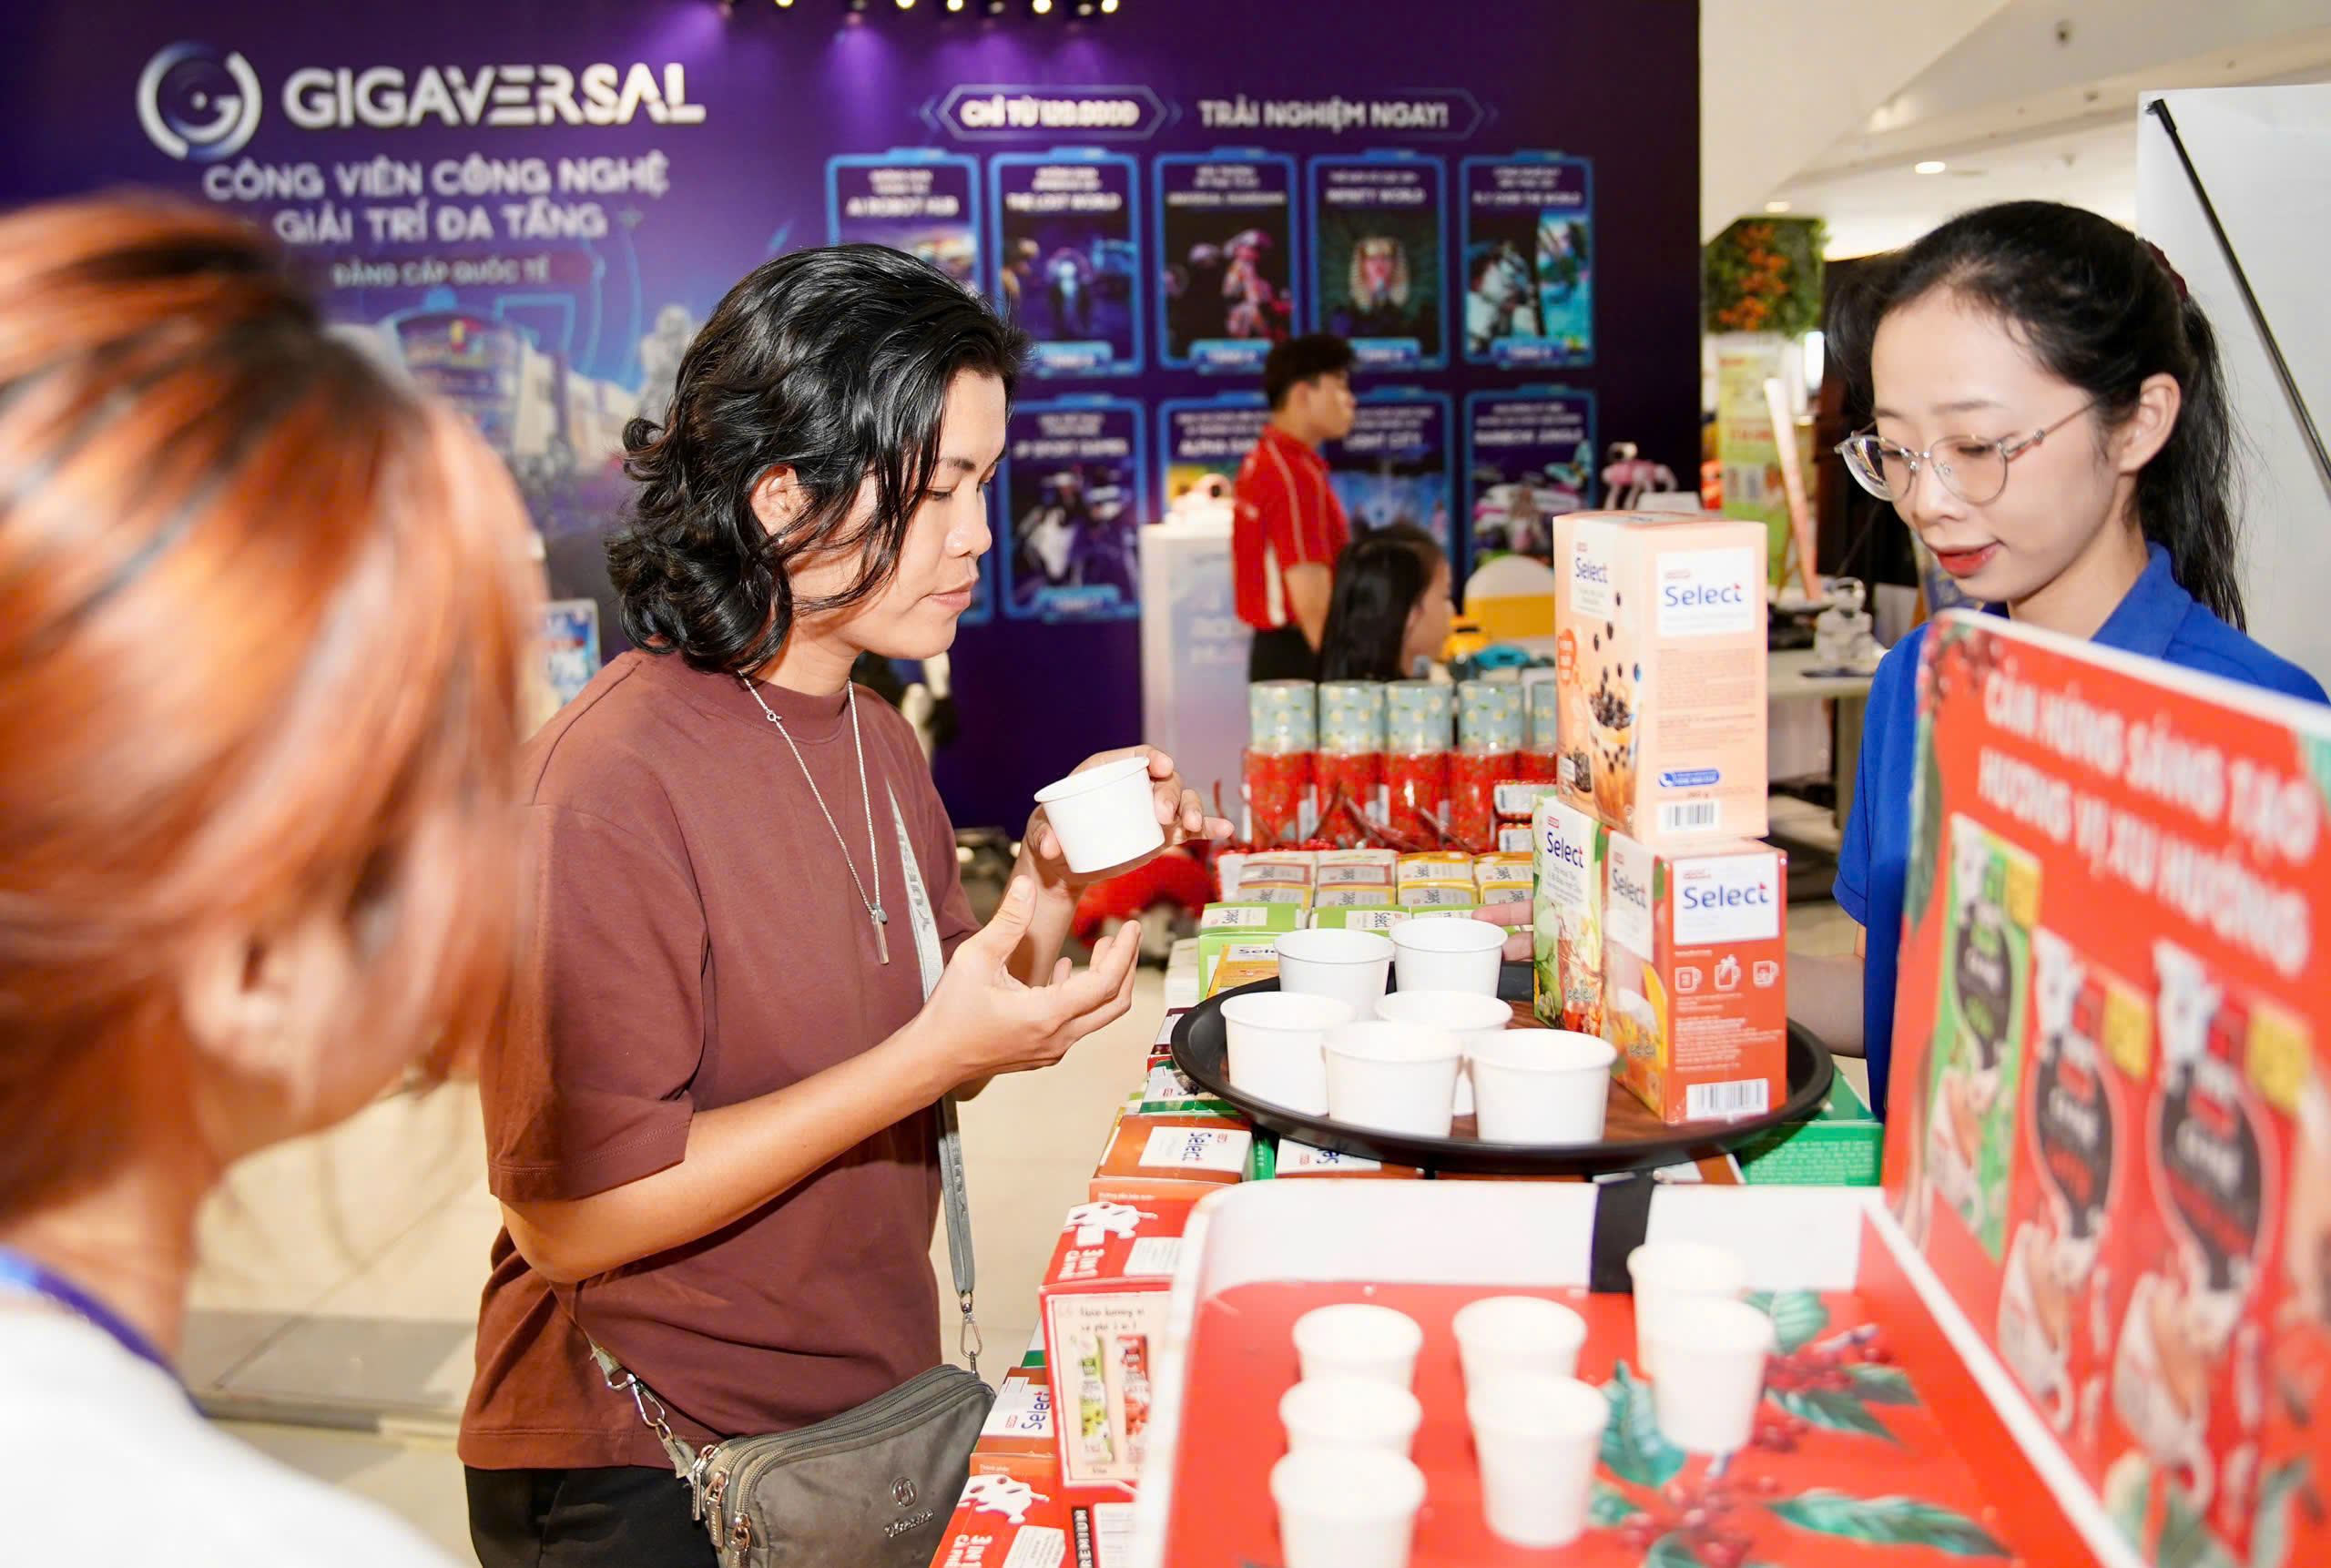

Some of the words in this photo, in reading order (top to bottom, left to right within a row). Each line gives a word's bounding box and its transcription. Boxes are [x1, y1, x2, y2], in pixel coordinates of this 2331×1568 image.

[281, 62, 707, 129] GIGAVERSAL
[1197, 95, 1259, 128] TRẢI
[1264, 96, 1365, 133] NGHIỆM
[1369, 100, 1450, 128] NGAY!
[202, 158, 324, 200] CÔNG
[333, 155, 422, 198] VIÊN
[432, 152, 550, 197] CÔNG
[559, 149, 670, 199] NGHỆ
[273, 206, 352, 245] GIẢI
[365, 198, 429, 243] TRÍ
[435, 207, 494, 242] ĐA
[1574, 556, 1609, 584] Select
[1664, 583, 1742, 608] Select
[1547, 831, 1583, 868] Select
[1612, 867, 1647, 911] Select
[1683, 881, 1770, 910] Select
[1182, 1131, 1213, 1162] Select
[1021, 1391, 1051, 1431] Select
[1074, 1509, 1093, 1568] REMIUM
